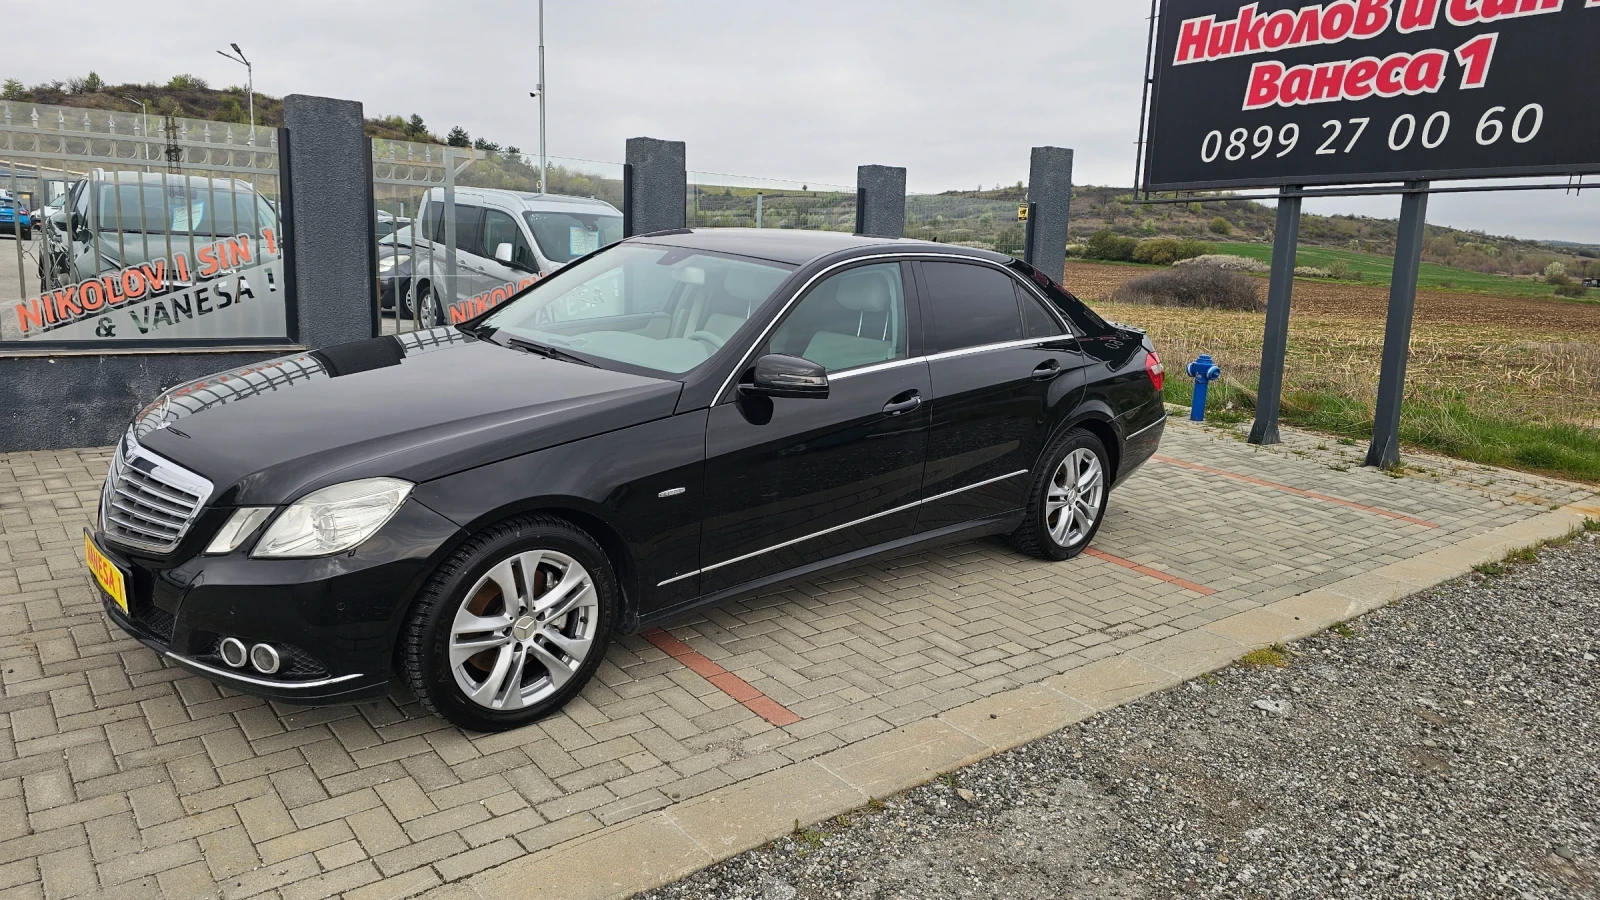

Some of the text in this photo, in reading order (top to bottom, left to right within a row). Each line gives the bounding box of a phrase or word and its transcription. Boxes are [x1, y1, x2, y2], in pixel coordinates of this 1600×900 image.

[1173, 0, 1392, 66] Николов
[1396, 0, 1441, 34] и
[1242, 32, 1499, 110] Ванеса 1
[1201, 102, 1544, 163] 0899 27 00 60
[14, 256, 167, 334] NIKOLOV
[172, 251, 191, 283] I
[196, 233, 252, 278] SIN
[95, 316, 116, 338] &
[129, 274, 255, 335] VANESA
[533, 285, 605, 325] ANESA
